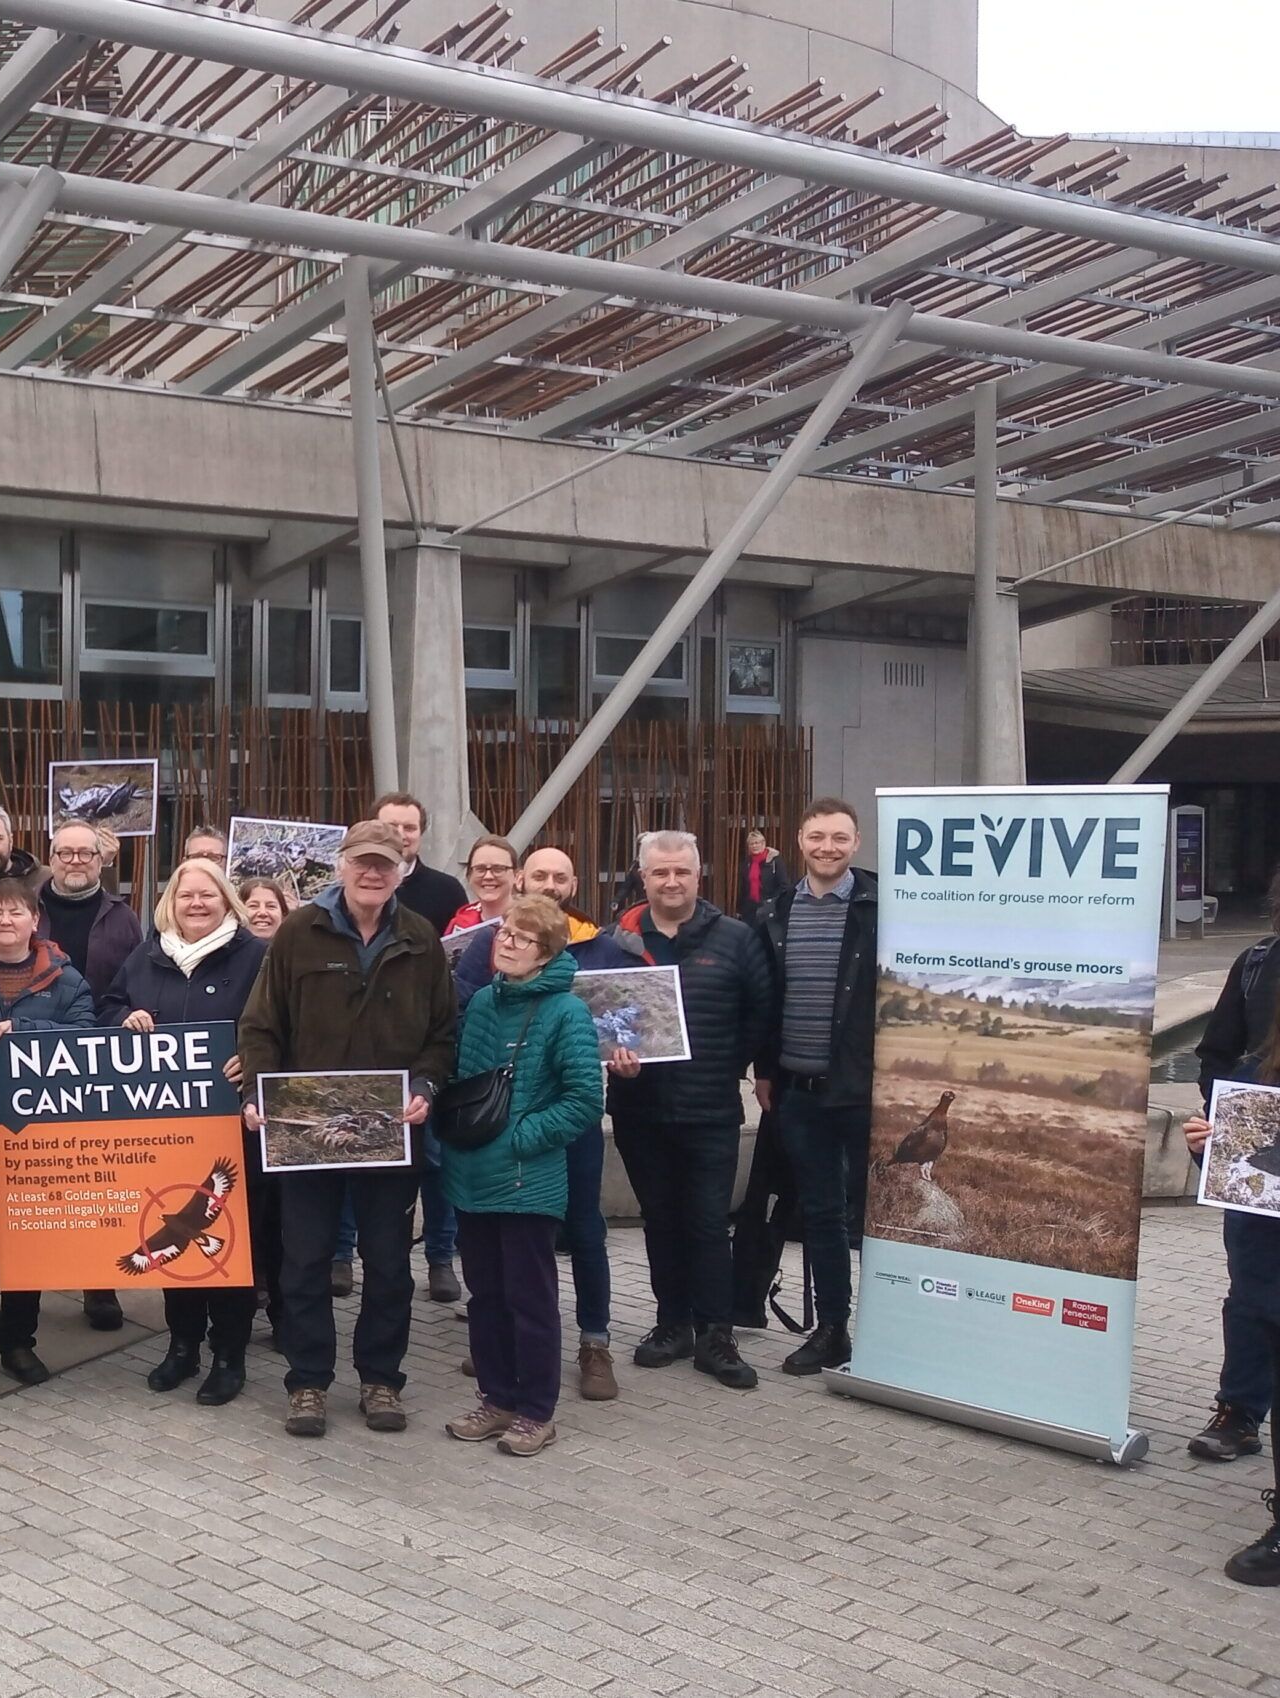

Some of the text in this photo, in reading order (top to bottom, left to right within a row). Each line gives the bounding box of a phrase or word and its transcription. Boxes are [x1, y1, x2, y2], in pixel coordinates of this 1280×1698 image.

[894, 814, 1141, 880] REVIVE
[894, 889, 1135, 906] The coalition for grouse moor reform
[896, 953, 1123, 975] Reform Scotland's grouse moors
[9, 1031, 212, 1079] NATURE
[11, 1080, 213, 1116] CAN'T WAIT
[4, 1134, 194, 1152] End bird of prey persecution
[5, 1152, 157, 1171] by passing the Wildlife
[6, 1171, 117, 1187] Management Bill
[6, 1189, 141, 1203] At least 68 Golden Eagles
[7, 1203, 139, 1217] have been illegally killed
[8, 1217, 126, 1230] in Scotland since 1981.
[975, 1290, 1006, 1302] LEAGUE
[1016, 1296, 1051, 1310] OneKind
[1072, 1301, 1098, 1312] Raptor
[1063, 1308, 1107, 1323] Persecution
[1078, 1320, 1089, 1328] UK
